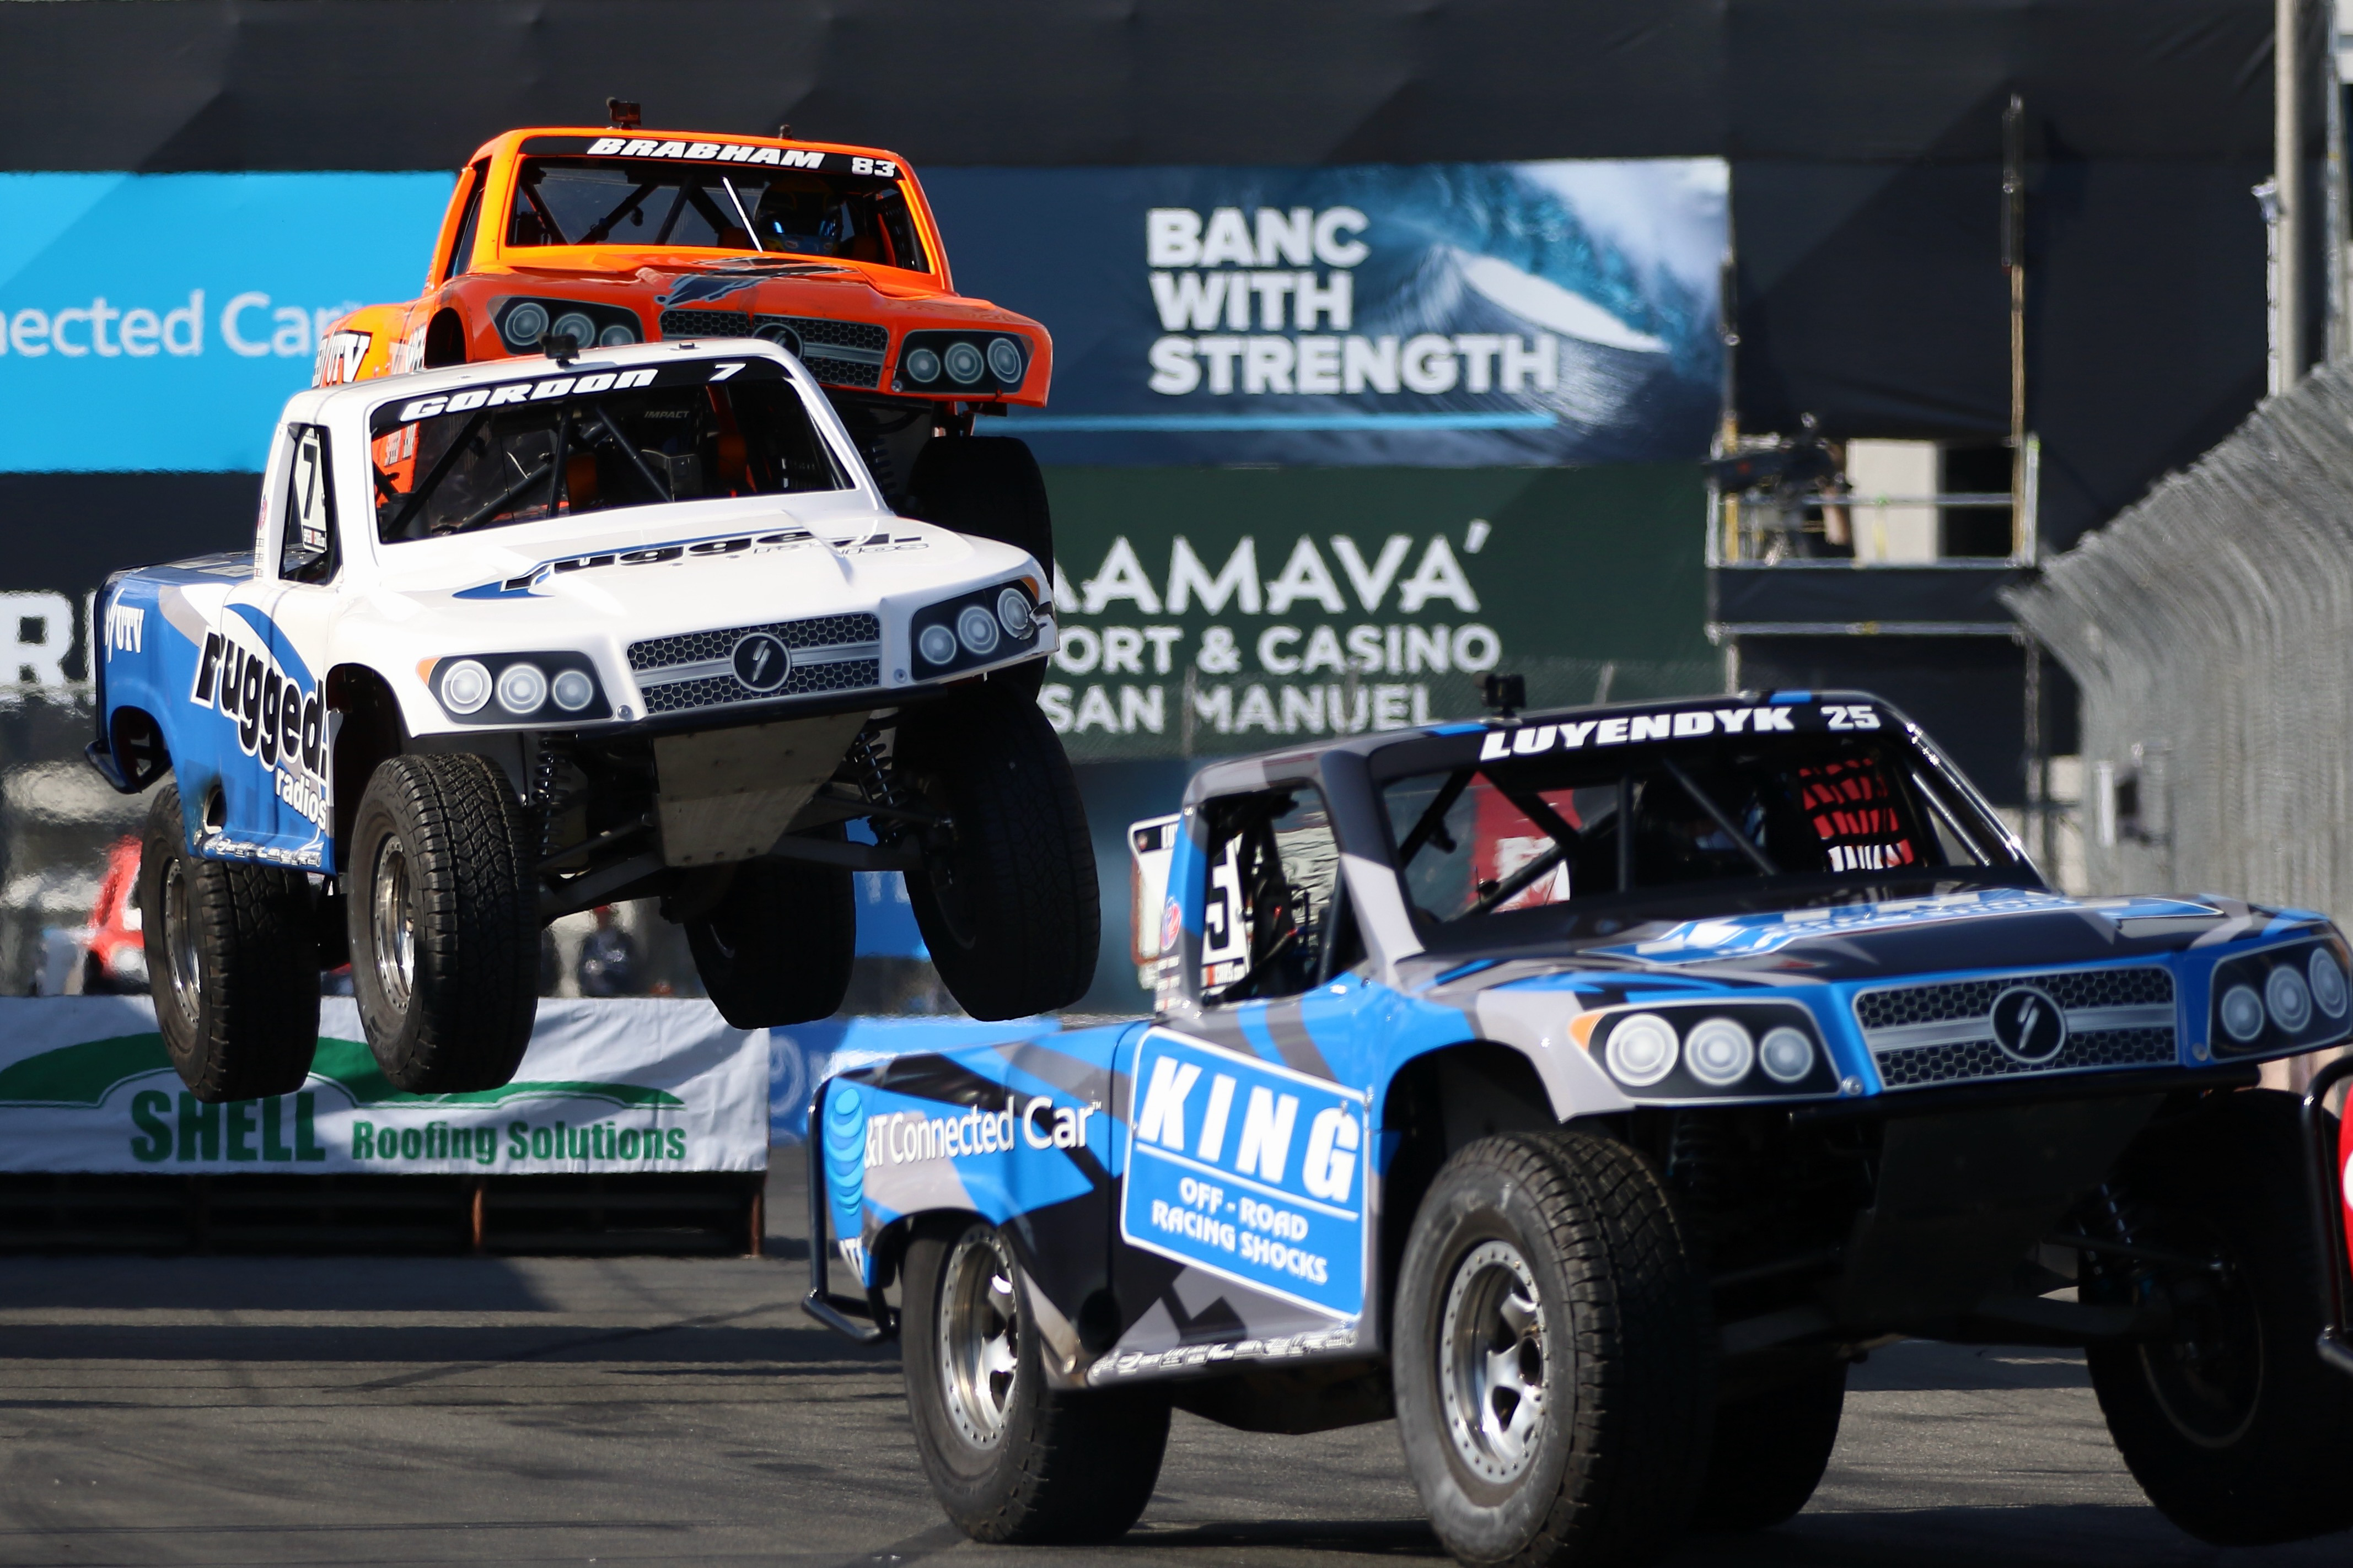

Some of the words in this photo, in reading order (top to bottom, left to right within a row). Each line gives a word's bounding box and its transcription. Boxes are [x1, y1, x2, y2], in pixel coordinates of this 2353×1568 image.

[587, 137, 825, 169] BRABHAM
[851, 157, 896, 177] 83
[1147, 207, 1369, 268] BANC
[0, 290, 204, 357] ected
[1149, 271, 1353, 331] WITH
[400, 368, 658, 422] GORDON
[709, 363, 746, 381] 7
[1149, 334, 1558, 395] STRENGTH
[1195, 626, 1242, 673] &
[1256, 623, 1502, 676] CASINO
[191, 626, 325, 773] rugged
[1036, 683, 1165, 735] SAN
[1194, 682, 1431, 735] MANUEL
[1480, 705, 1794, 761] LUYENDYK
[1820, 705, 1881, 731] 25
[277, 765, 326, 831] radios
[130, 1090, 326, 1162] SHELL
[352, 1119, 497, 1165] Roofing
[507, 1120, 687, 1161] Solutions
[890, 1095, 1014, 1164] Connected
[1136, 1054, 1360, 1203] KING
[1179, 1176, 1223, 1214] OFF
[1239, 1197, 1308, 1241] ROAD
[1151, 1199, 1235, 1253] RACING
[1239, 1231, 1328, 1285] SHOCKS
